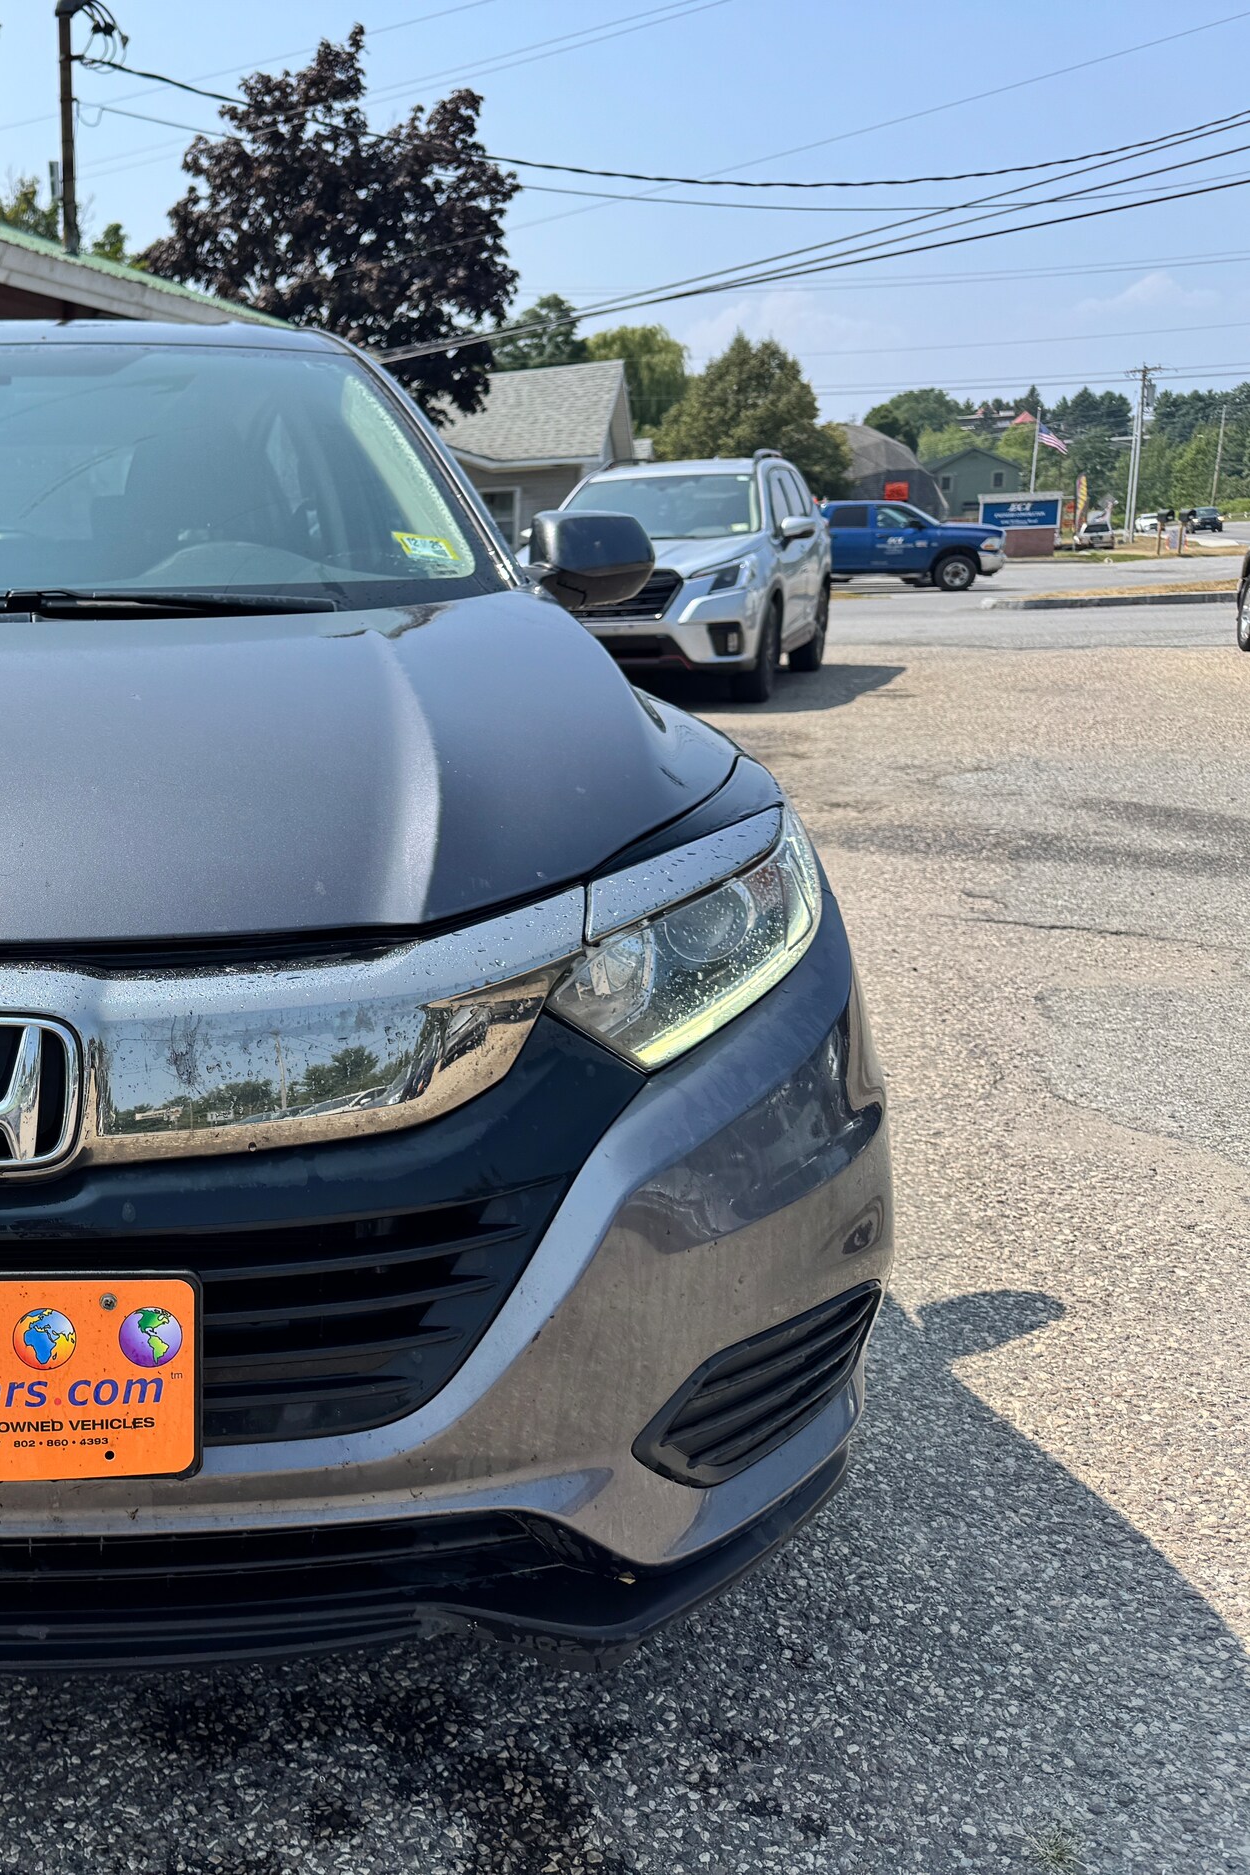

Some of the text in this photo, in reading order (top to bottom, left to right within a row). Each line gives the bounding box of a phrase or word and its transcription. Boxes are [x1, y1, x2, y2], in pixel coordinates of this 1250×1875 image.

[69, 1417, 155, 1431] VEHICLES
[13, 1440, 36, 1448] 802
[46, 1439, 69, 1447] 860
[79, 1437, 109, 1446] 4393
